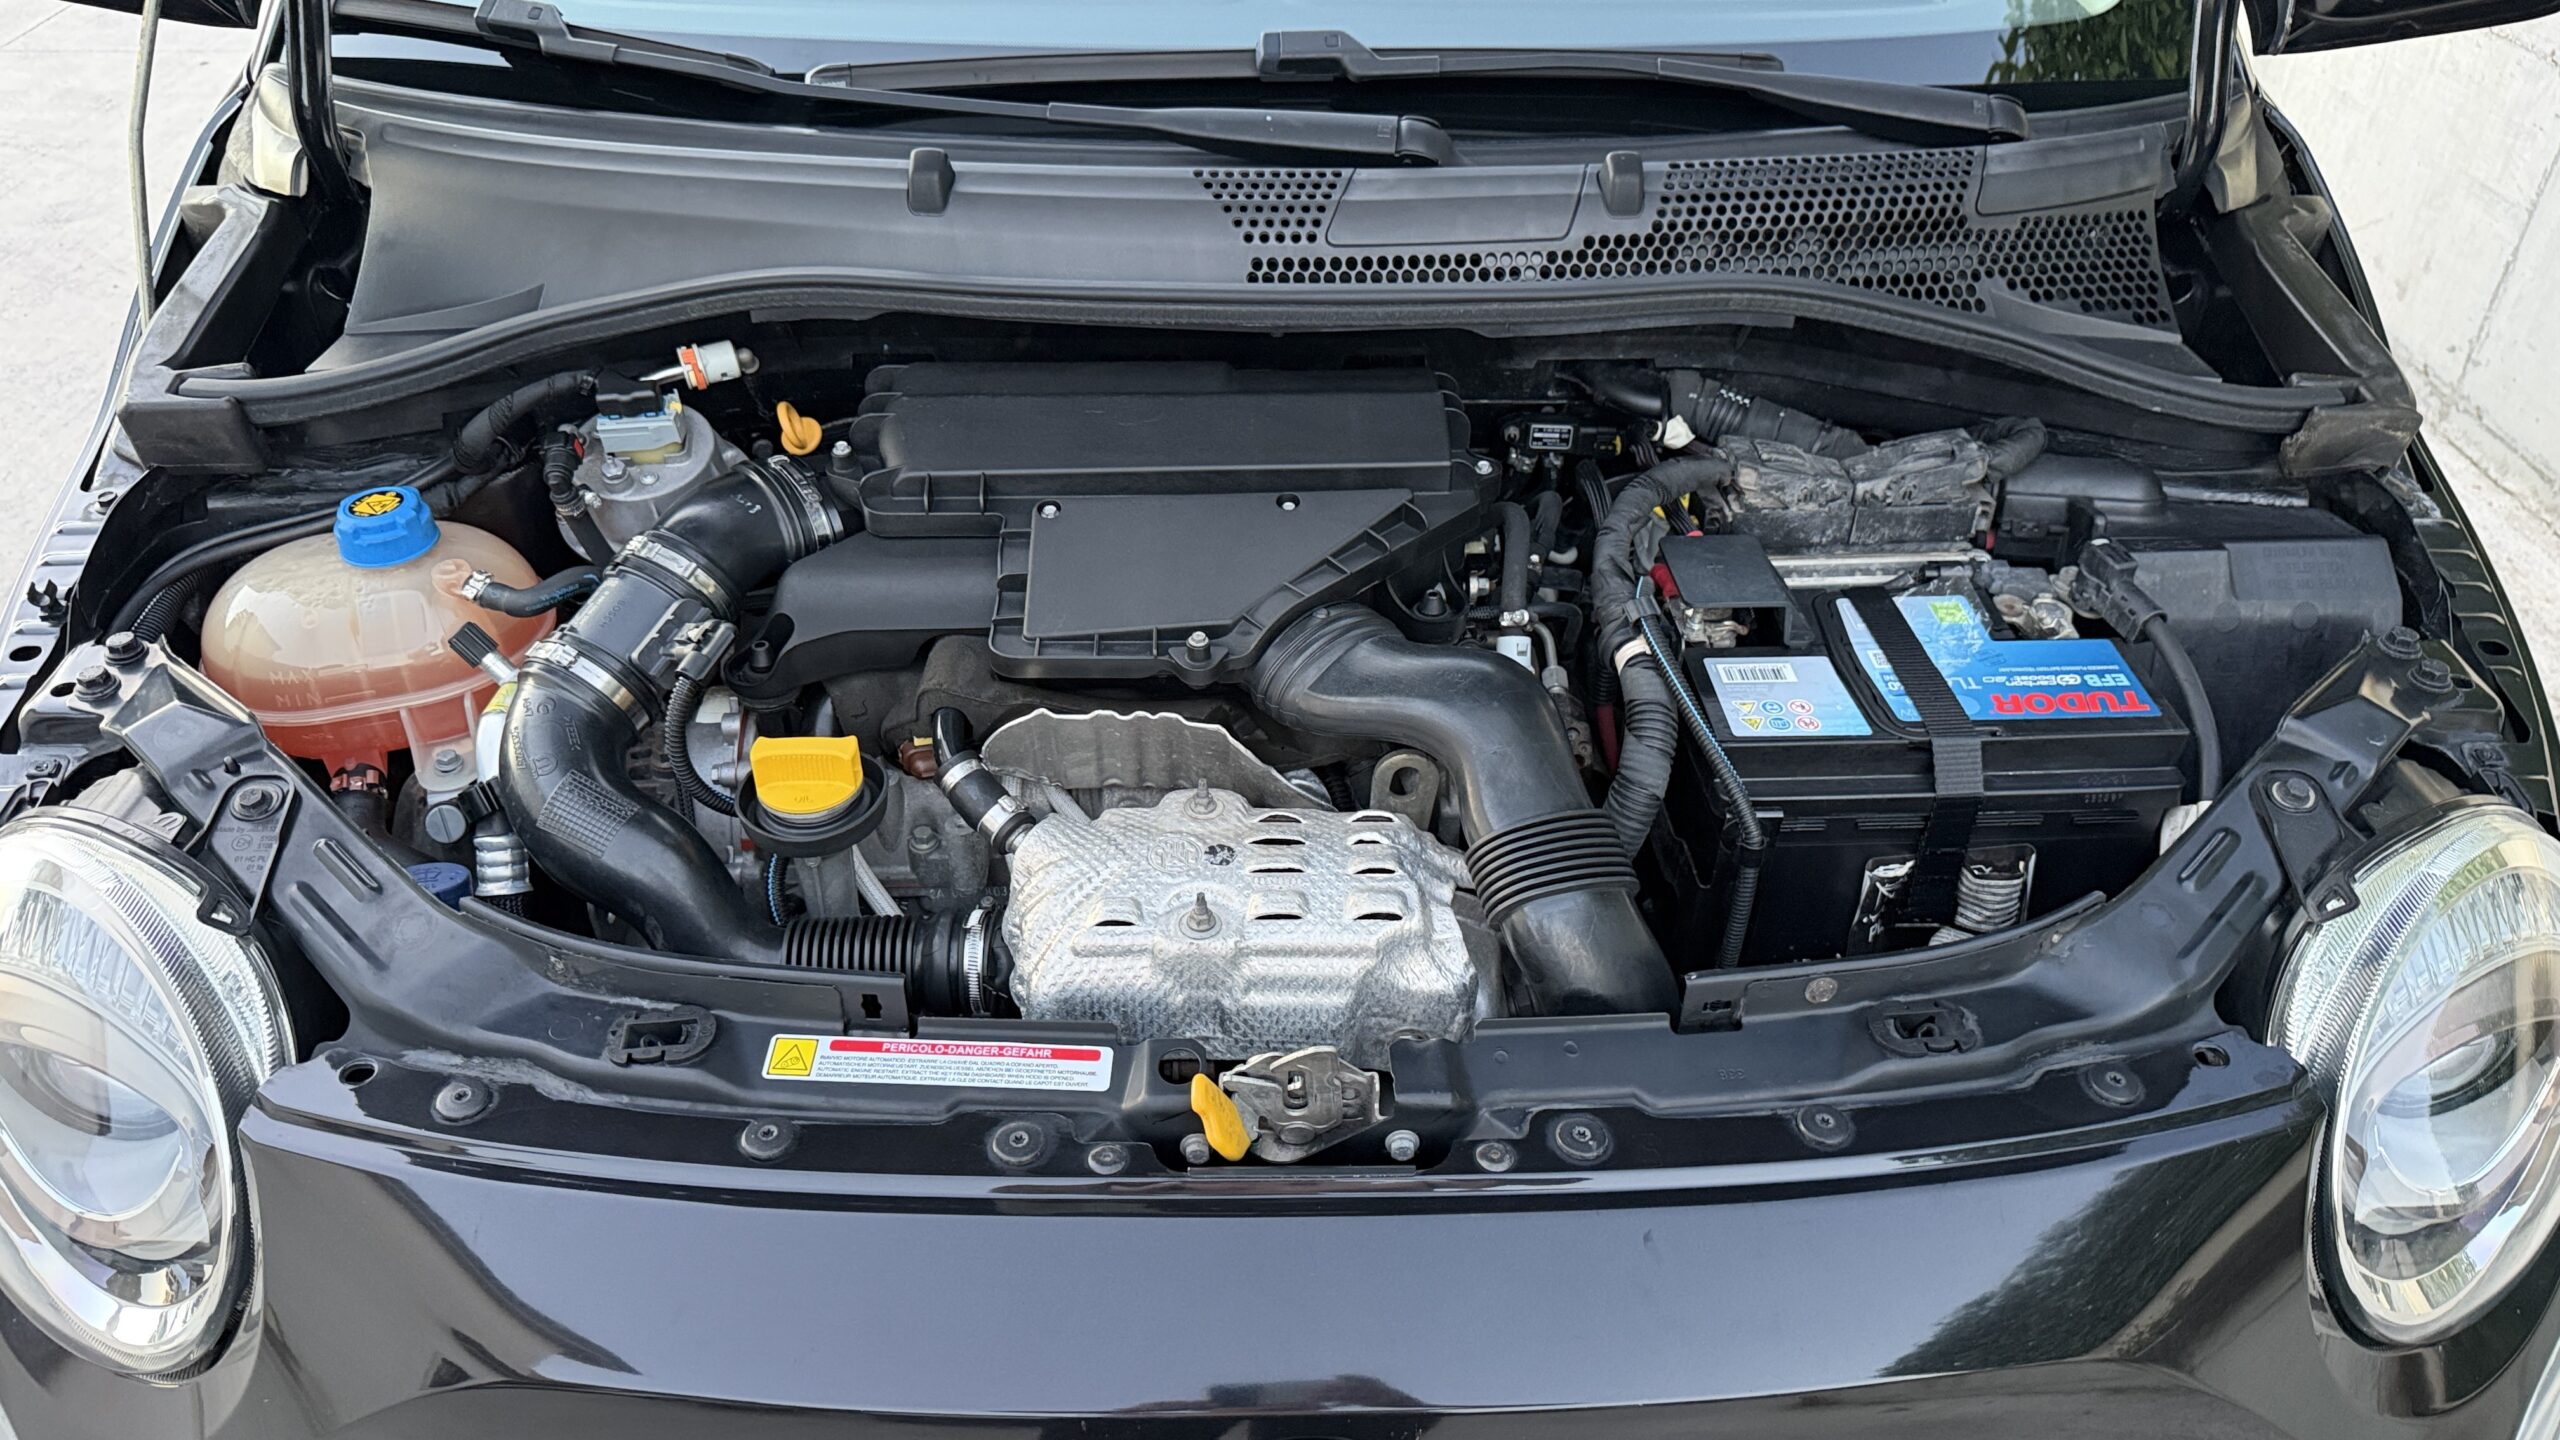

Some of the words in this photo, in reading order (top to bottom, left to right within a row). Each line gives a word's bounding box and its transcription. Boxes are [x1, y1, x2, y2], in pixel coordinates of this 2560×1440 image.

[269, 666, 314, 685] MAX
[2006, 679, 2056, 687] carbon
[2084, 673, 2131, 687] EFB
[275, 692, 322, 707] MIN
[1991, 690, 2151, 714] TUDOR
[882, 1042, 1053, 1058] PERICOLO-DANGER-GEFAHR
